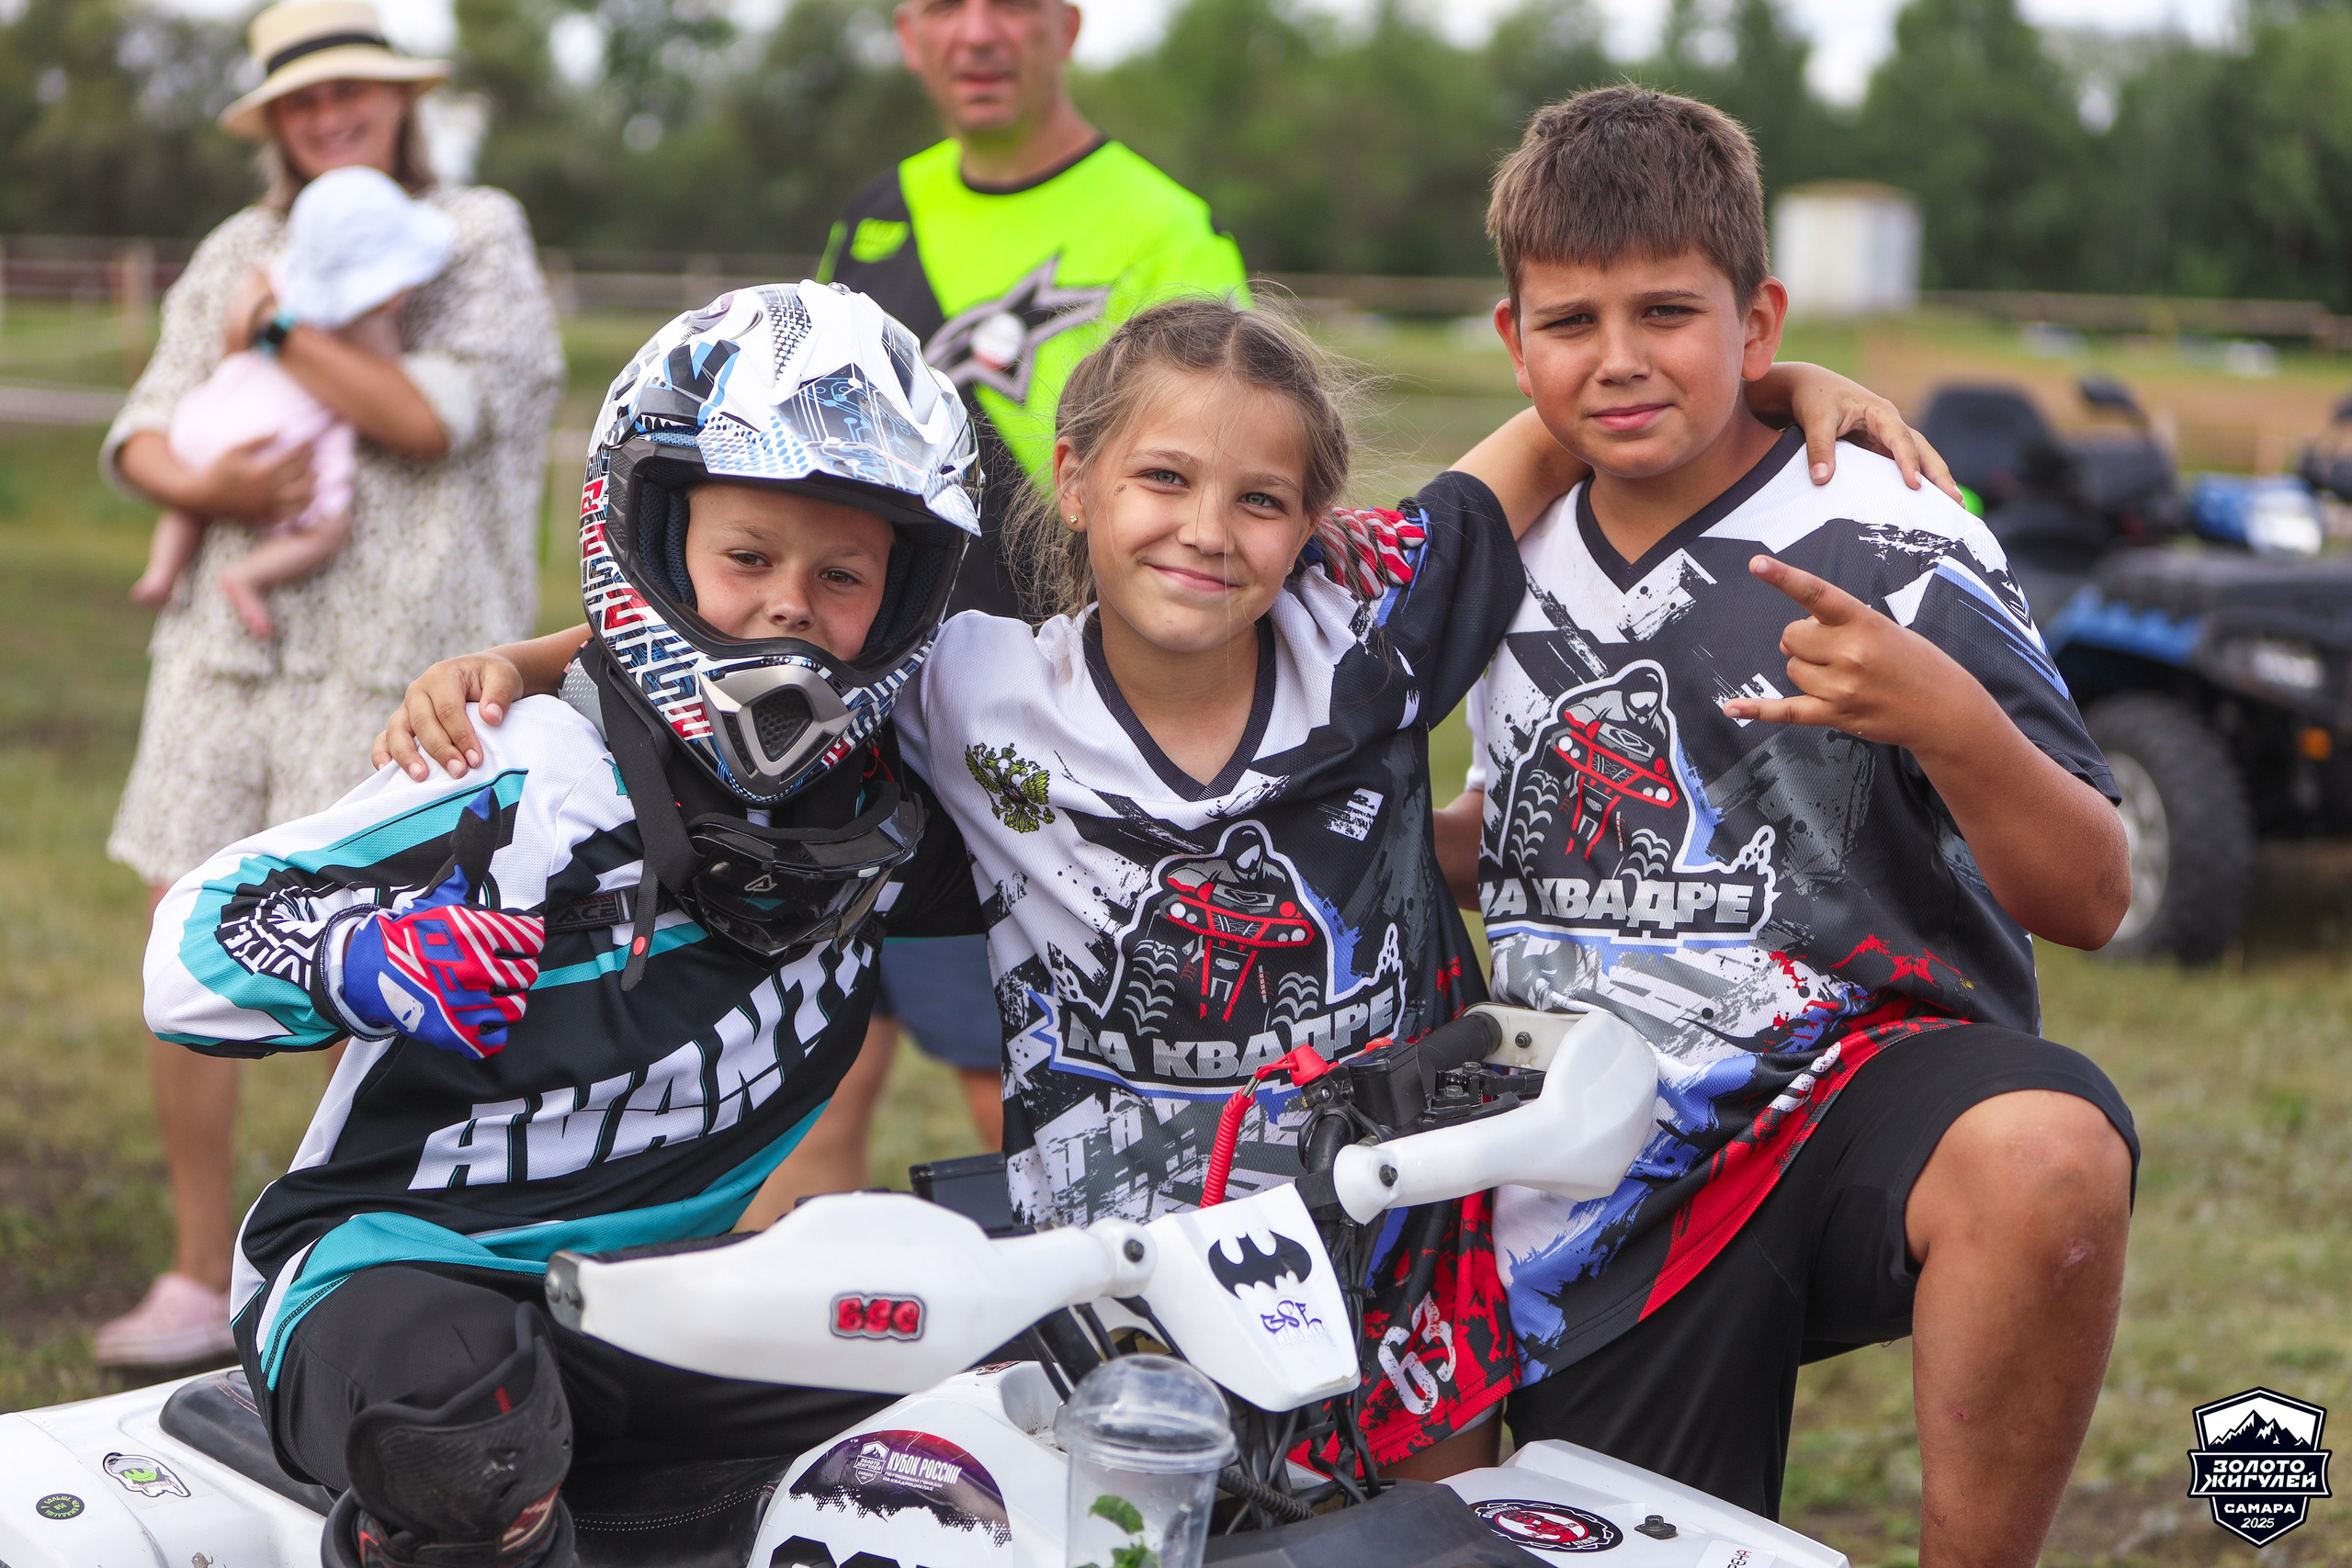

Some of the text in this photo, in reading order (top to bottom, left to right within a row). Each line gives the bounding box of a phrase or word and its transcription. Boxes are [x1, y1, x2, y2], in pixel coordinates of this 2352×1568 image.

[1532, 878, 1754, 930] КВАДРЕ
[1067, 986, 1395, 1078] НА КВАДРЕ
[1377, 1290, 1457, 1416] 63
[887, 1451, 963, 1484] КУБОК РОССИИ
